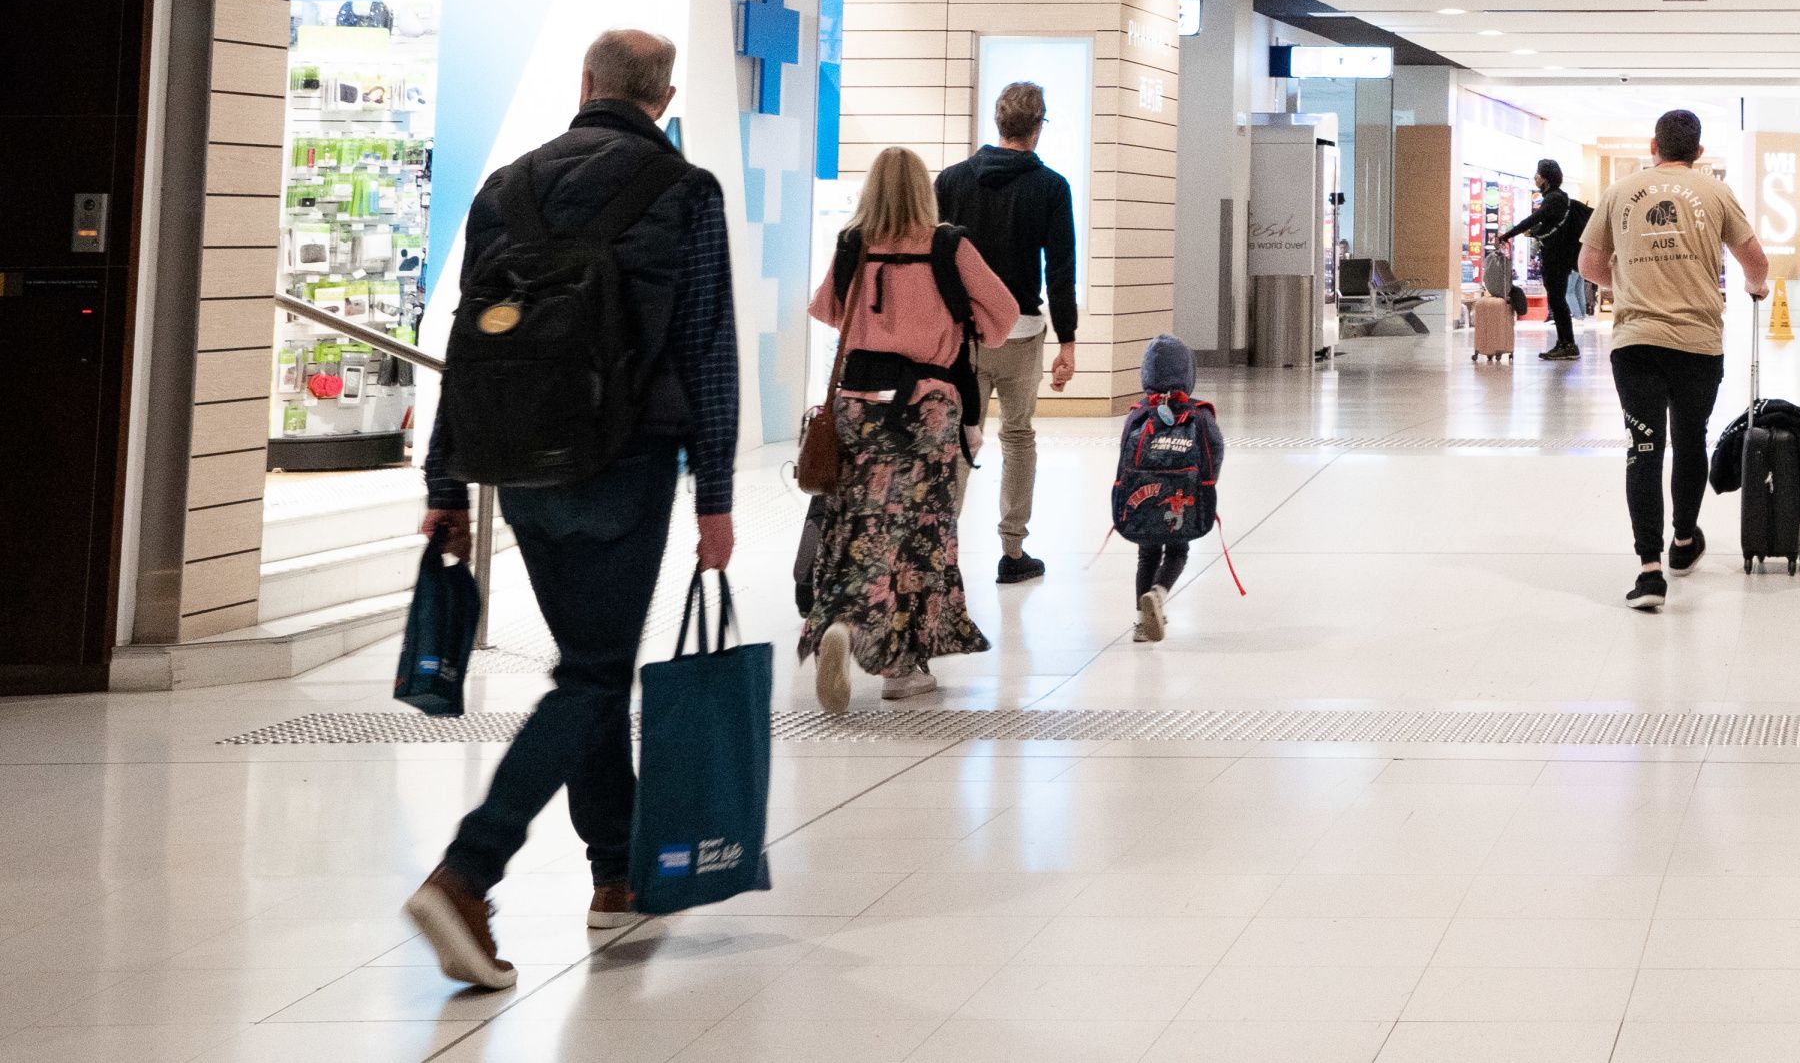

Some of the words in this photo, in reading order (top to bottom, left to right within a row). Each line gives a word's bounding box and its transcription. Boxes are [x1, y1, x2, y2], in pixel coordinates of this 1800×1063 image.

[1764, 153, 1796, 173] WH
[1761, 172, 1798, 243] S
[1257, 241, 1282, 250] world
[1285, 241, 1306, 250] over!
[1652, 238, 1678, 249] AUS.
[1150, 436, 1193, 447] AMAZING
